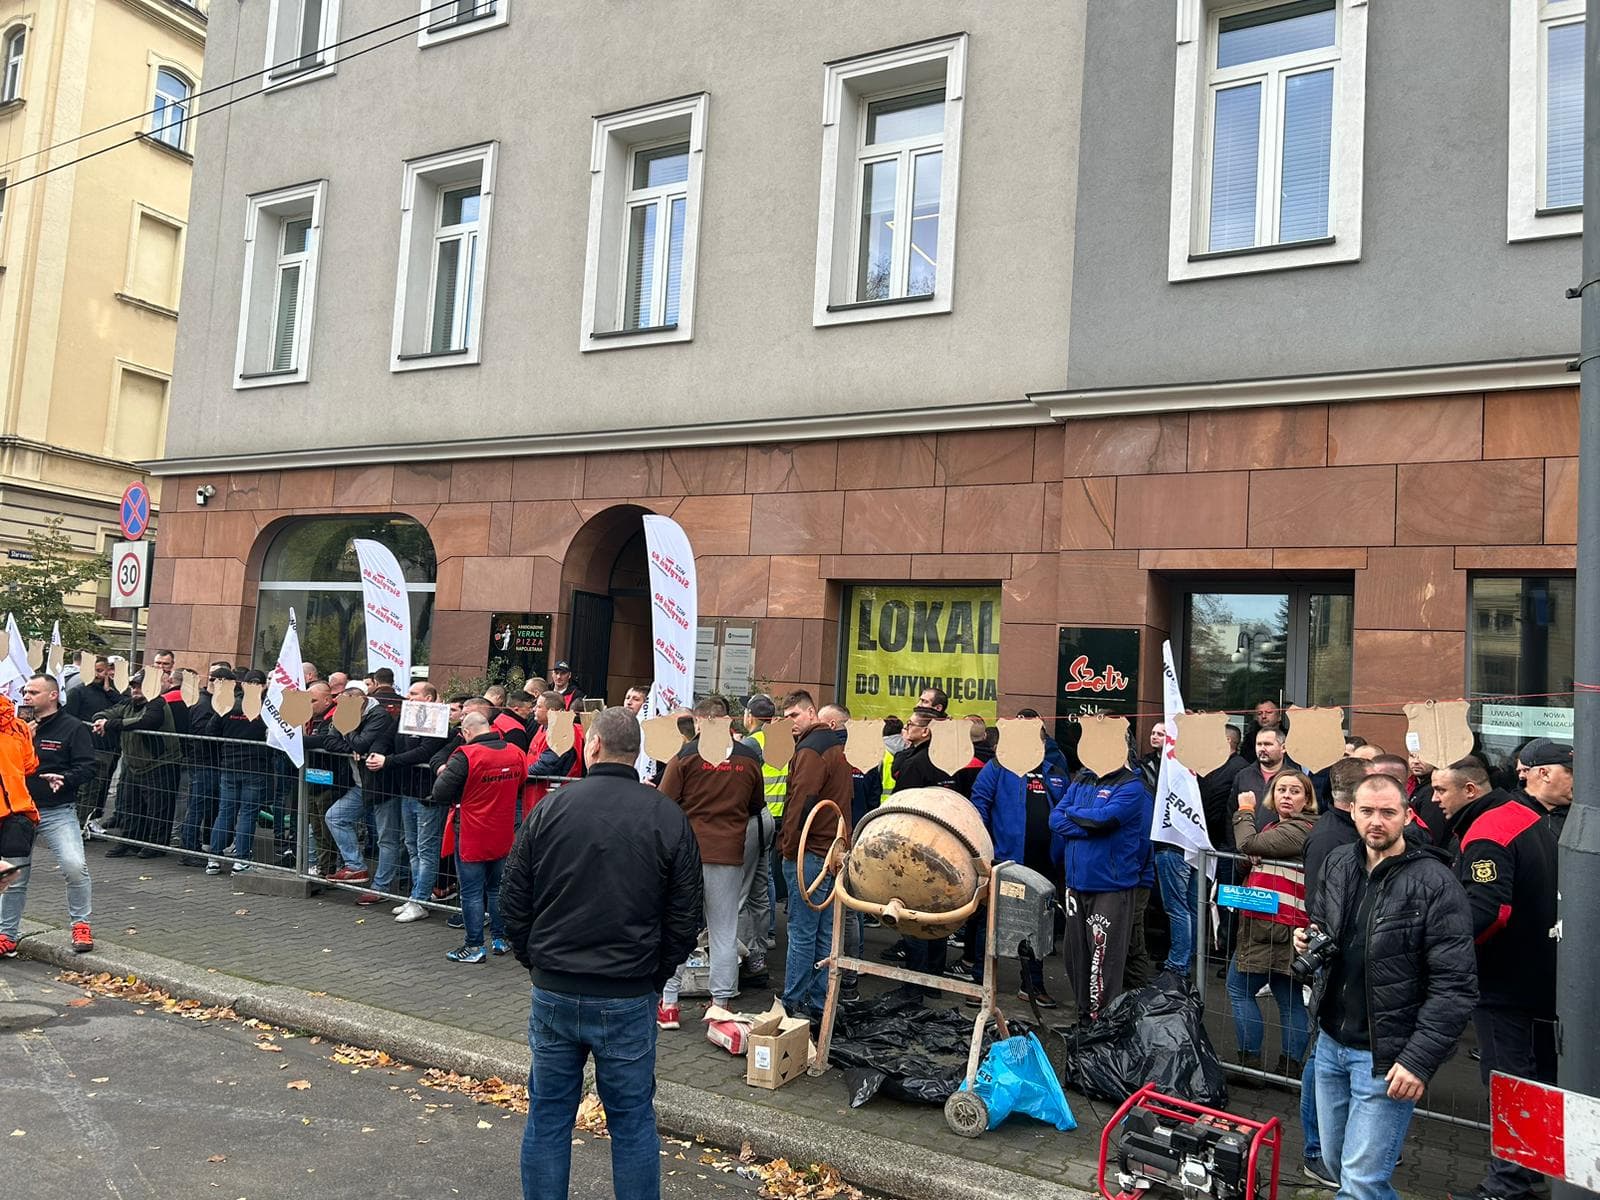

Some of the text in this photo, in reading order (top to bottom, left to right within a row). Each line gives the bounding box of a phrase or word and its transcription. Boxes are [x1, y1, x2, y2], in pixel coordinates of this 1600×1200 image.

[121, 564, 137, 585] 30
[517, 630, 545, 638] VERACE
[857, 600, 999, 655] LOKAL
[515, 638, 544, 647] PIZZA
[855, 673, 880, 695] DO
[1490, 710, 1523, 718] UWAGA!
